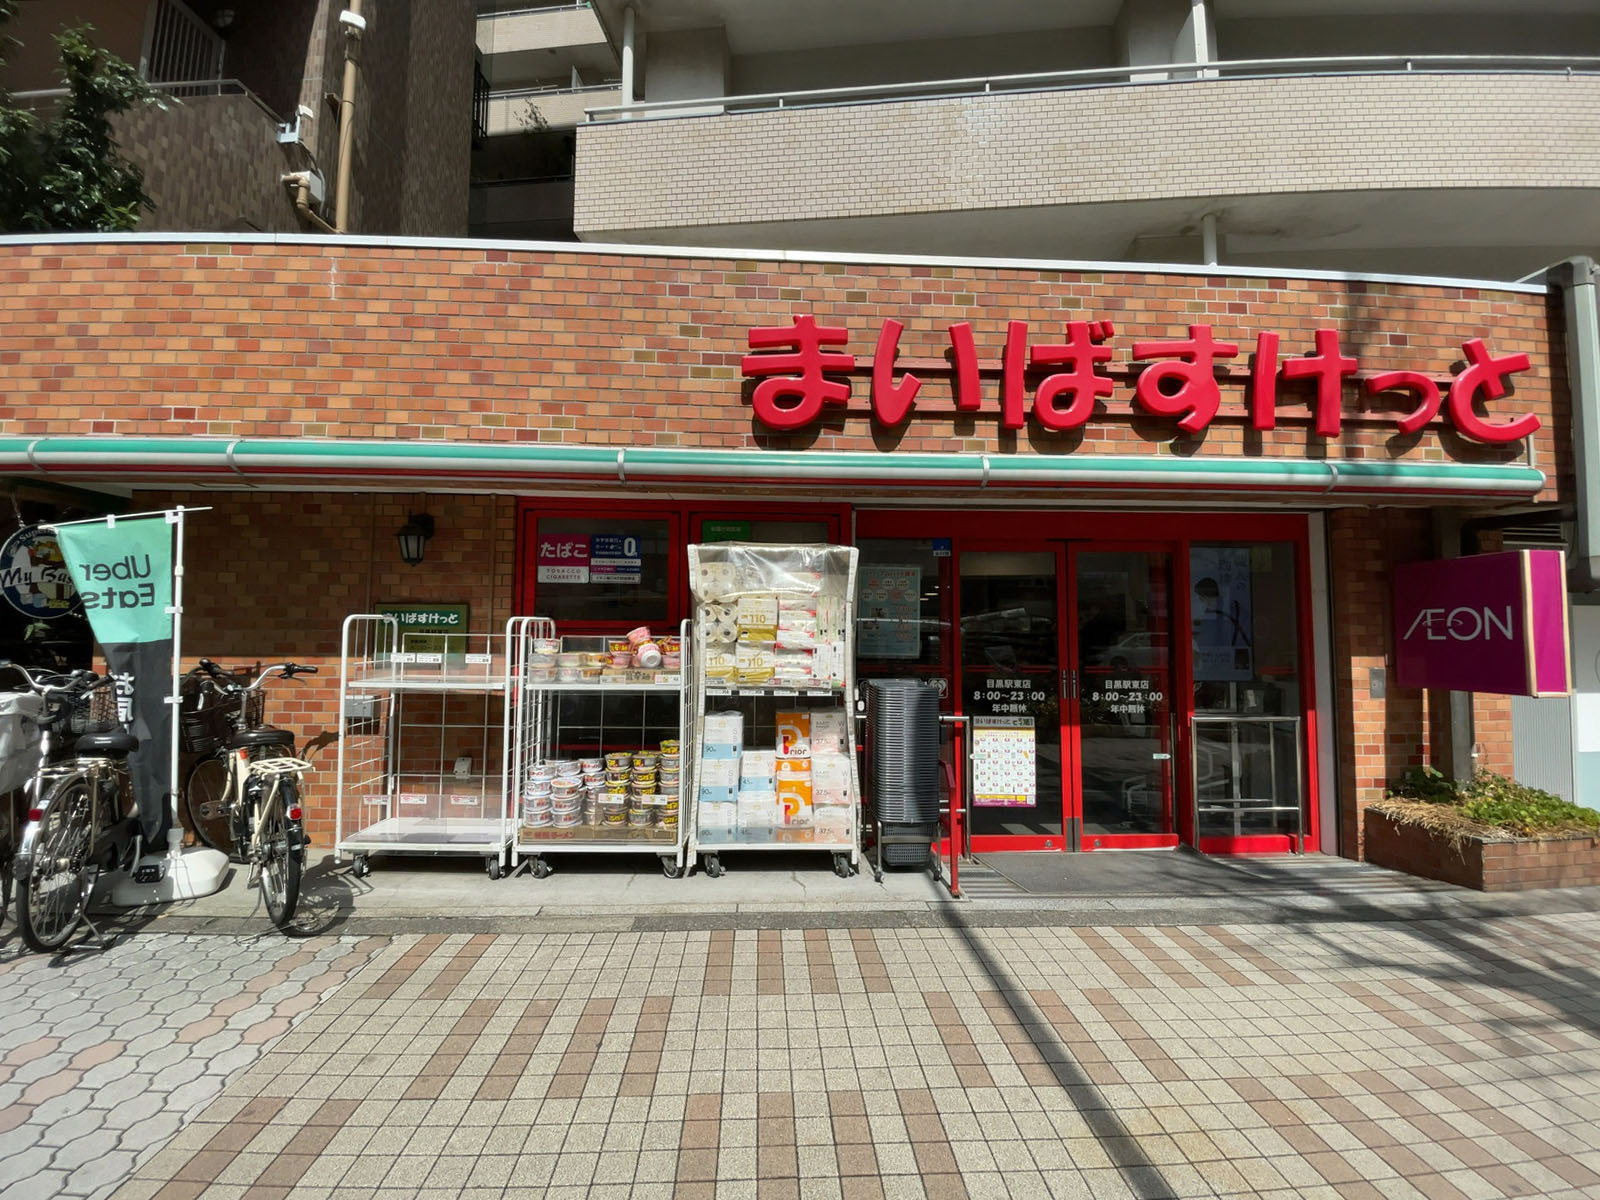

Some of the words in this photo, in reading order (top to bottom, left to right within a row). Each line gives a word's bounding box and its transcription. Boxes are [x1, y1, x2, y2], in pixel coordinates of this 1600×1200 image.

[741, 313, 1541, 444] まいばすけっと
[541, 541, 588, 559] たばこ
[1, 567, 33, 587] My
[41, 566, 74, 583] Bas
